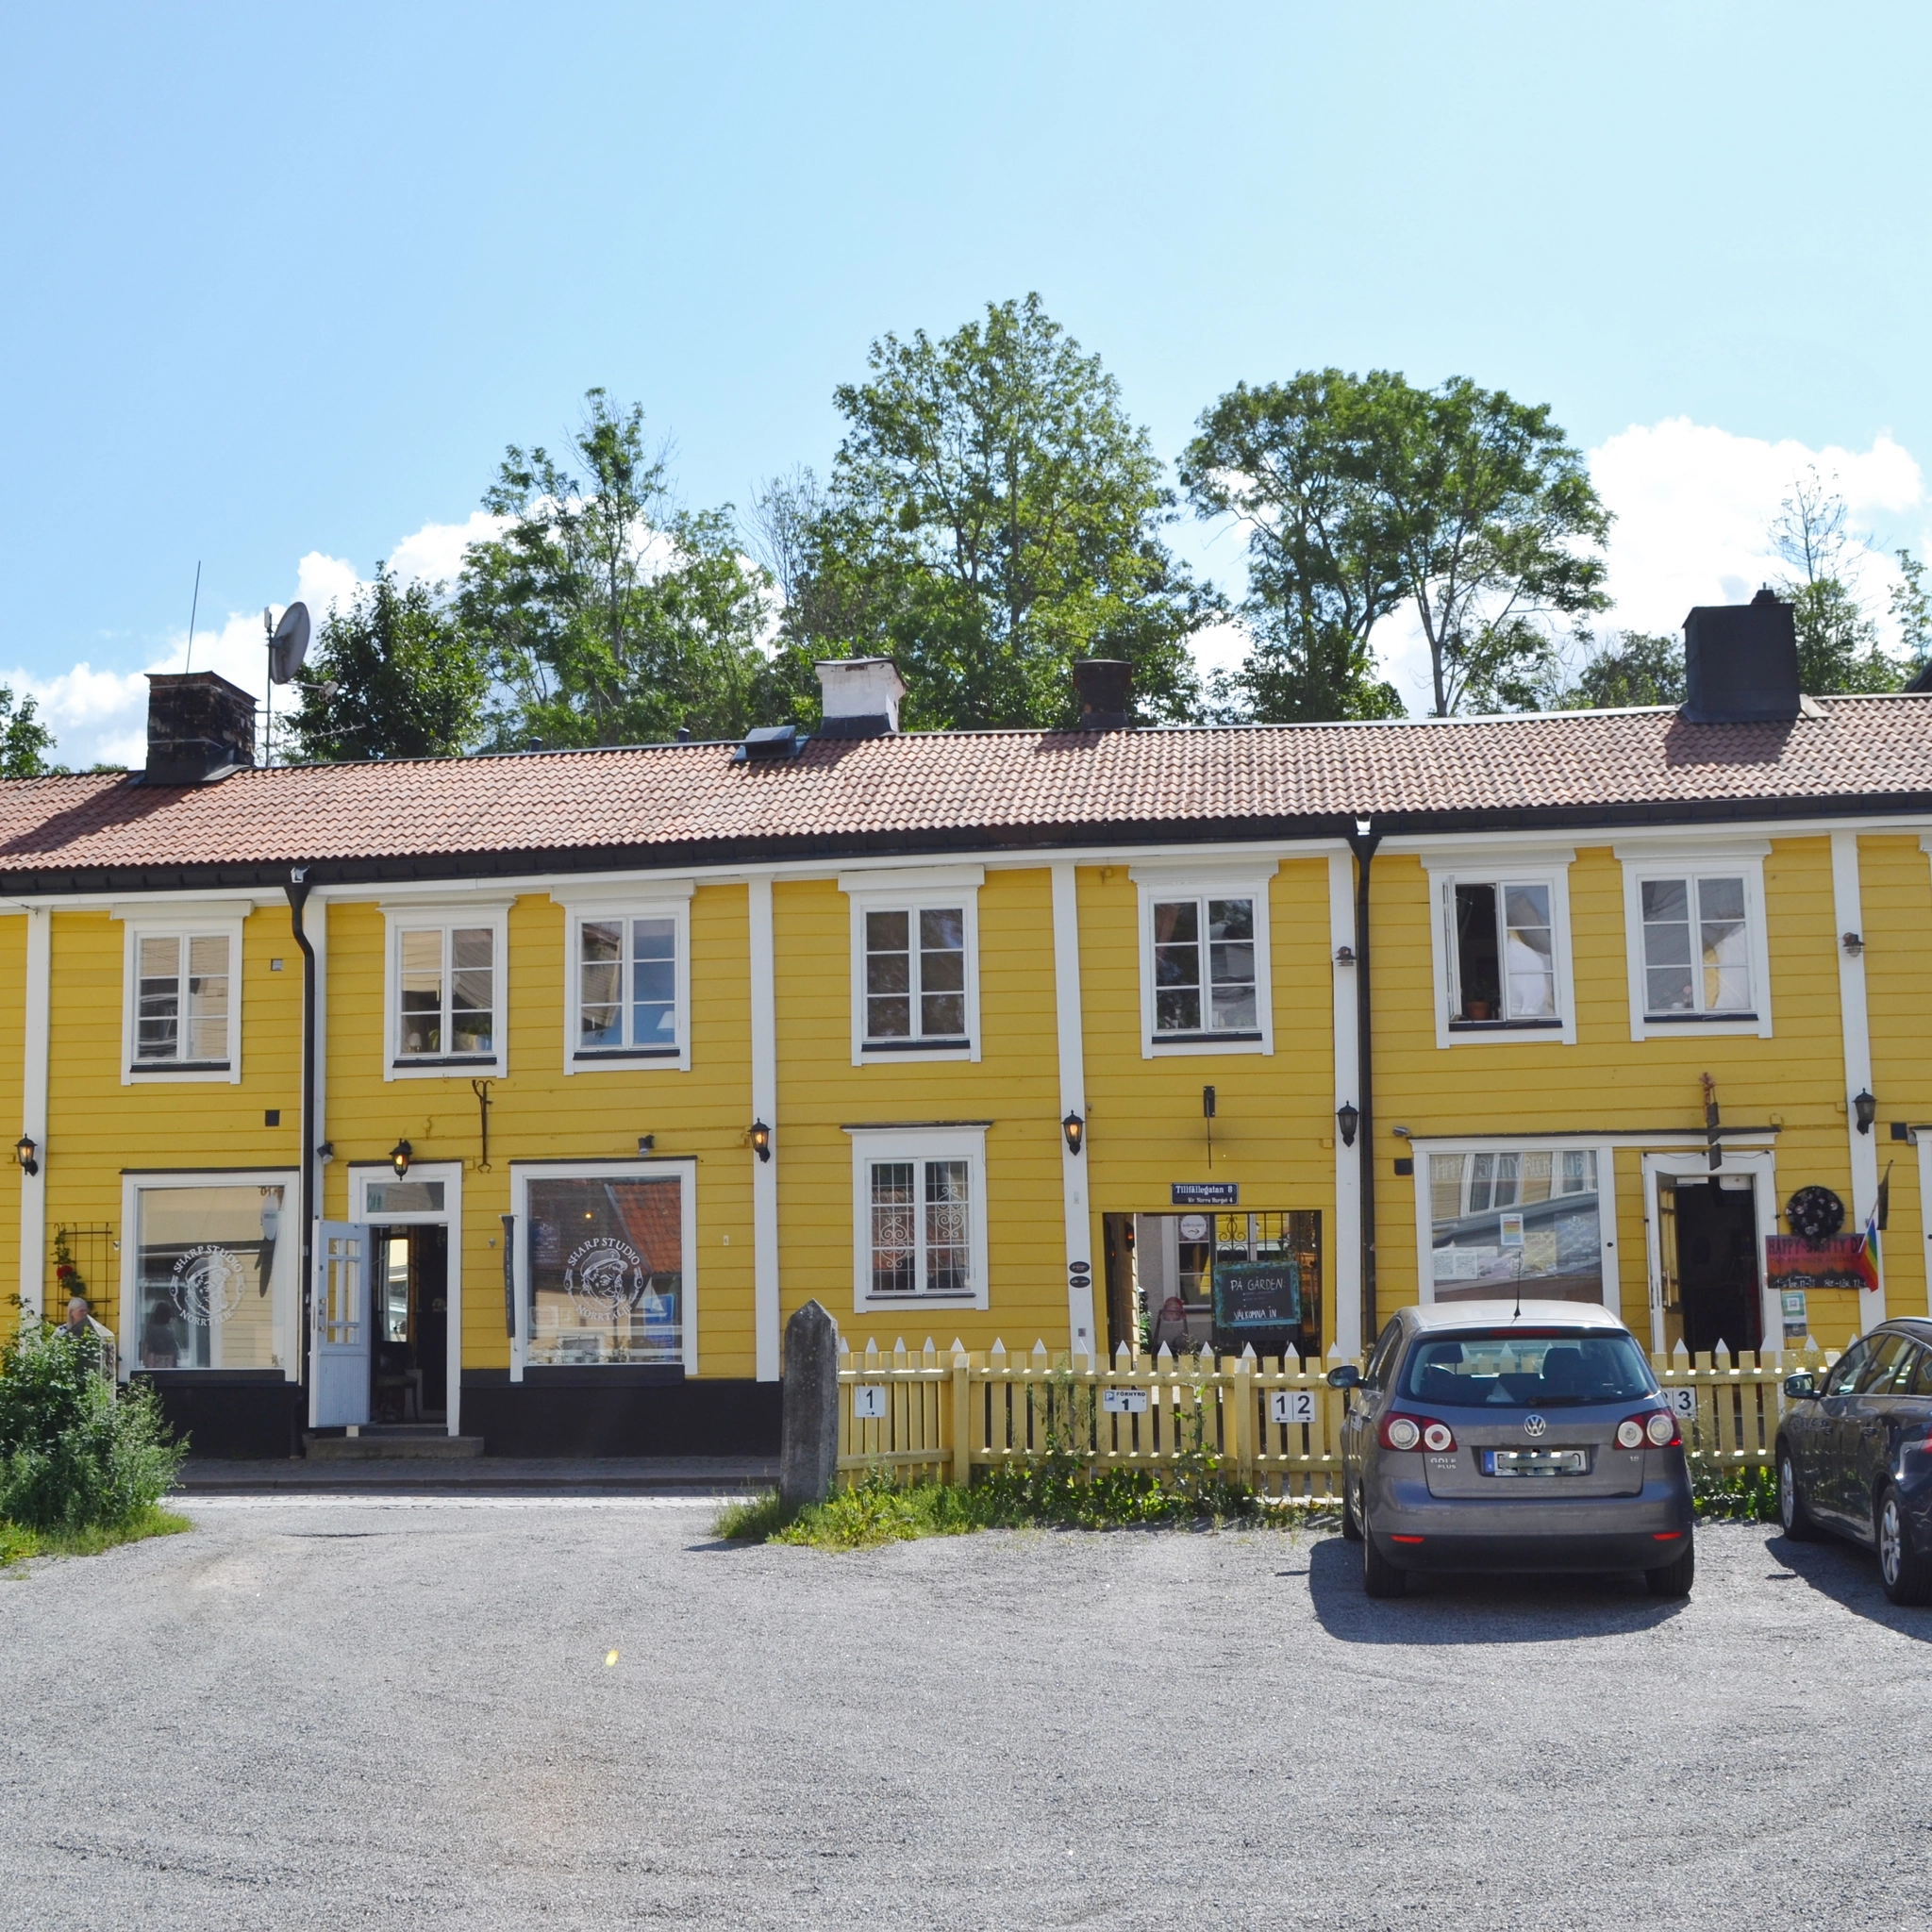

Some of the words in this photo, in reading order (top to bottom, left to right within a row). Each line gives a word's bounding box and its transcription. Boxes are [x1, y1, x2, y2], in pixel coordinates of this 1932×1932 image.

[1175, 1185, 1224, 1195] Tillfällegatan
[1227, 1185, 1233, 1193] 8
[567, 1238, 600, 1267] SHARP
[601, 1237, 641, 1265] STUDIO
[1768, 1238, 1801, 1256] HAPPY
[174, 1245, 204, 1274] SHARP
[207, 1244, 242, 1273] STUDIO
[1230, 1277, 1243, 1291] PÅ
[866, 1389, 873, 1408] 1
[1122, 1398, 1129, 1410] 1
[1276, 1395, 1285, 1414] 1
[1297, 1395, 1310, 1414] 2
[1678, 1391, 1691, 1410] 3
